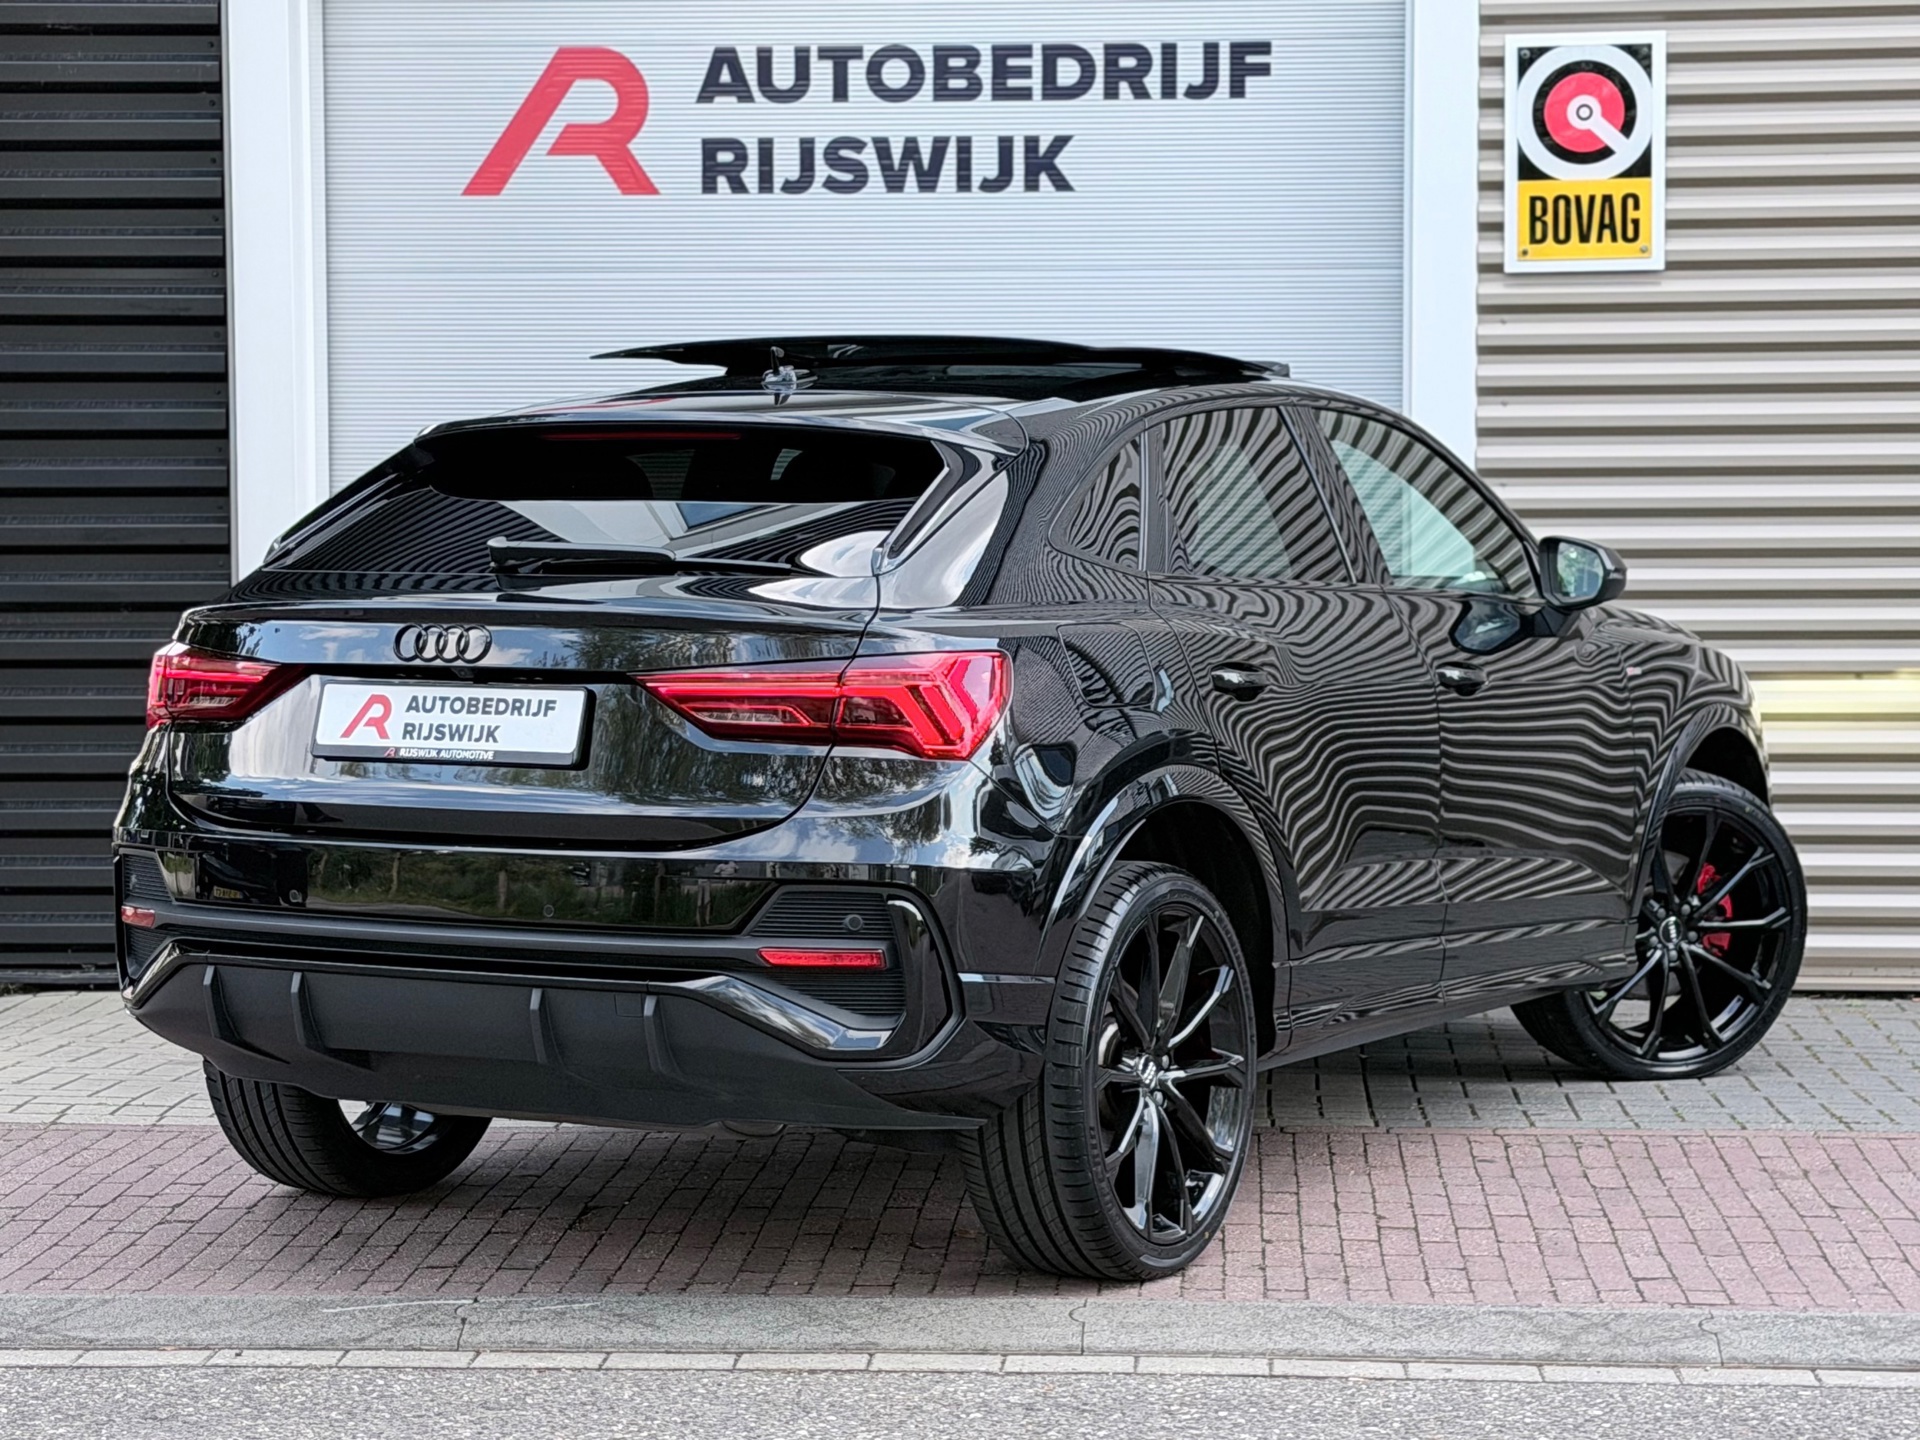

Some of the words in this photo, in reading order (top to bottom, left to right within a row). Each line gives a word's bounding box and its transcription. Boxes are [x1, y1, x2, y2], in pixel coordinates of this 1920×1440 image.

[695, 41, 1273, 104] AUTOBEDRIJF
[700, 134, 1076, 195] RIJSWIJK
[1529, 192, 1641, 245] BOVAG
[405, 695, 557, 718] AUTOBEDRIJF
[402, 722, 501, 744] RIJSWIJK
[399, 748, 438, 758] RIJSWIJK
[439, 749, 495, 760] AUTOMOTIVE
